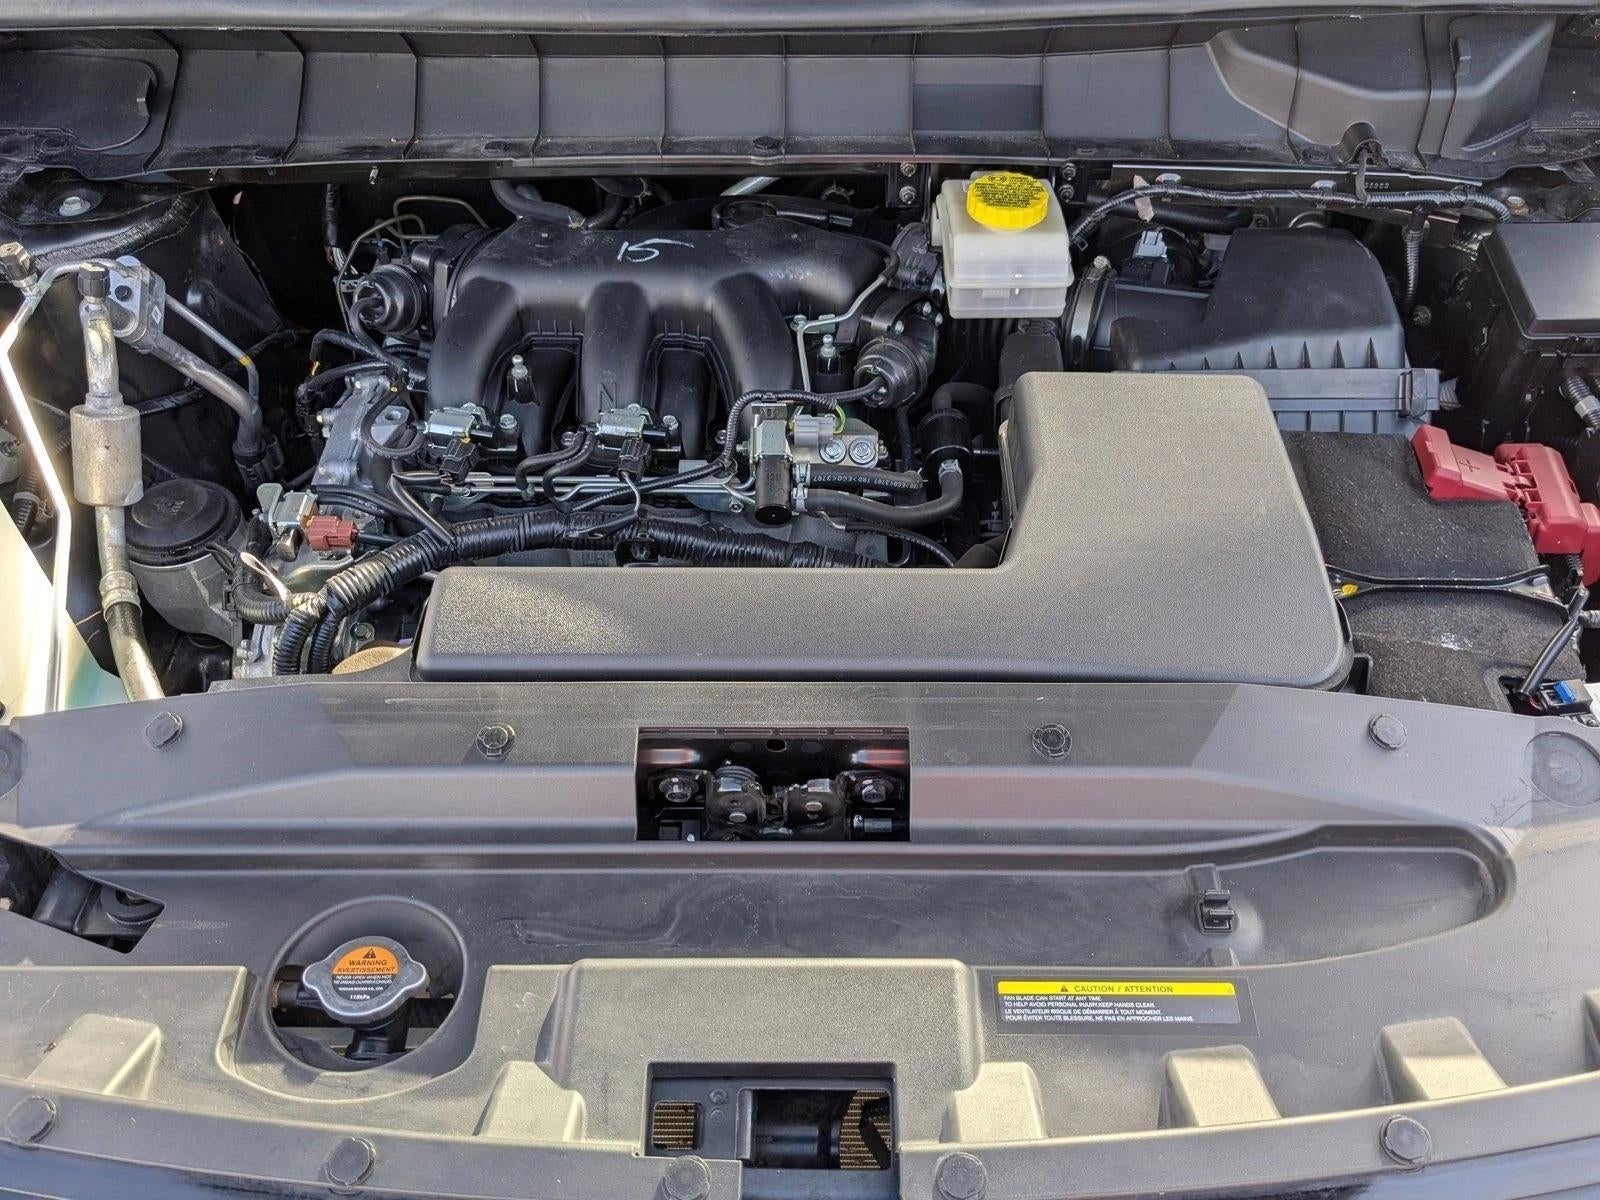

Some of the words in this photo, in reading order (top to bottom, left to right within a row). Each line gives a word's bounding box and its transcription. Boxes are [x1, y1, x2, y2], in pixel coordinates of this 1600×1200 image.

[617, 238, 694, 263] 15
[1074, 985, 1114, 993] CAUTION
[1124, 985, 1173, 993] ATTENTION
